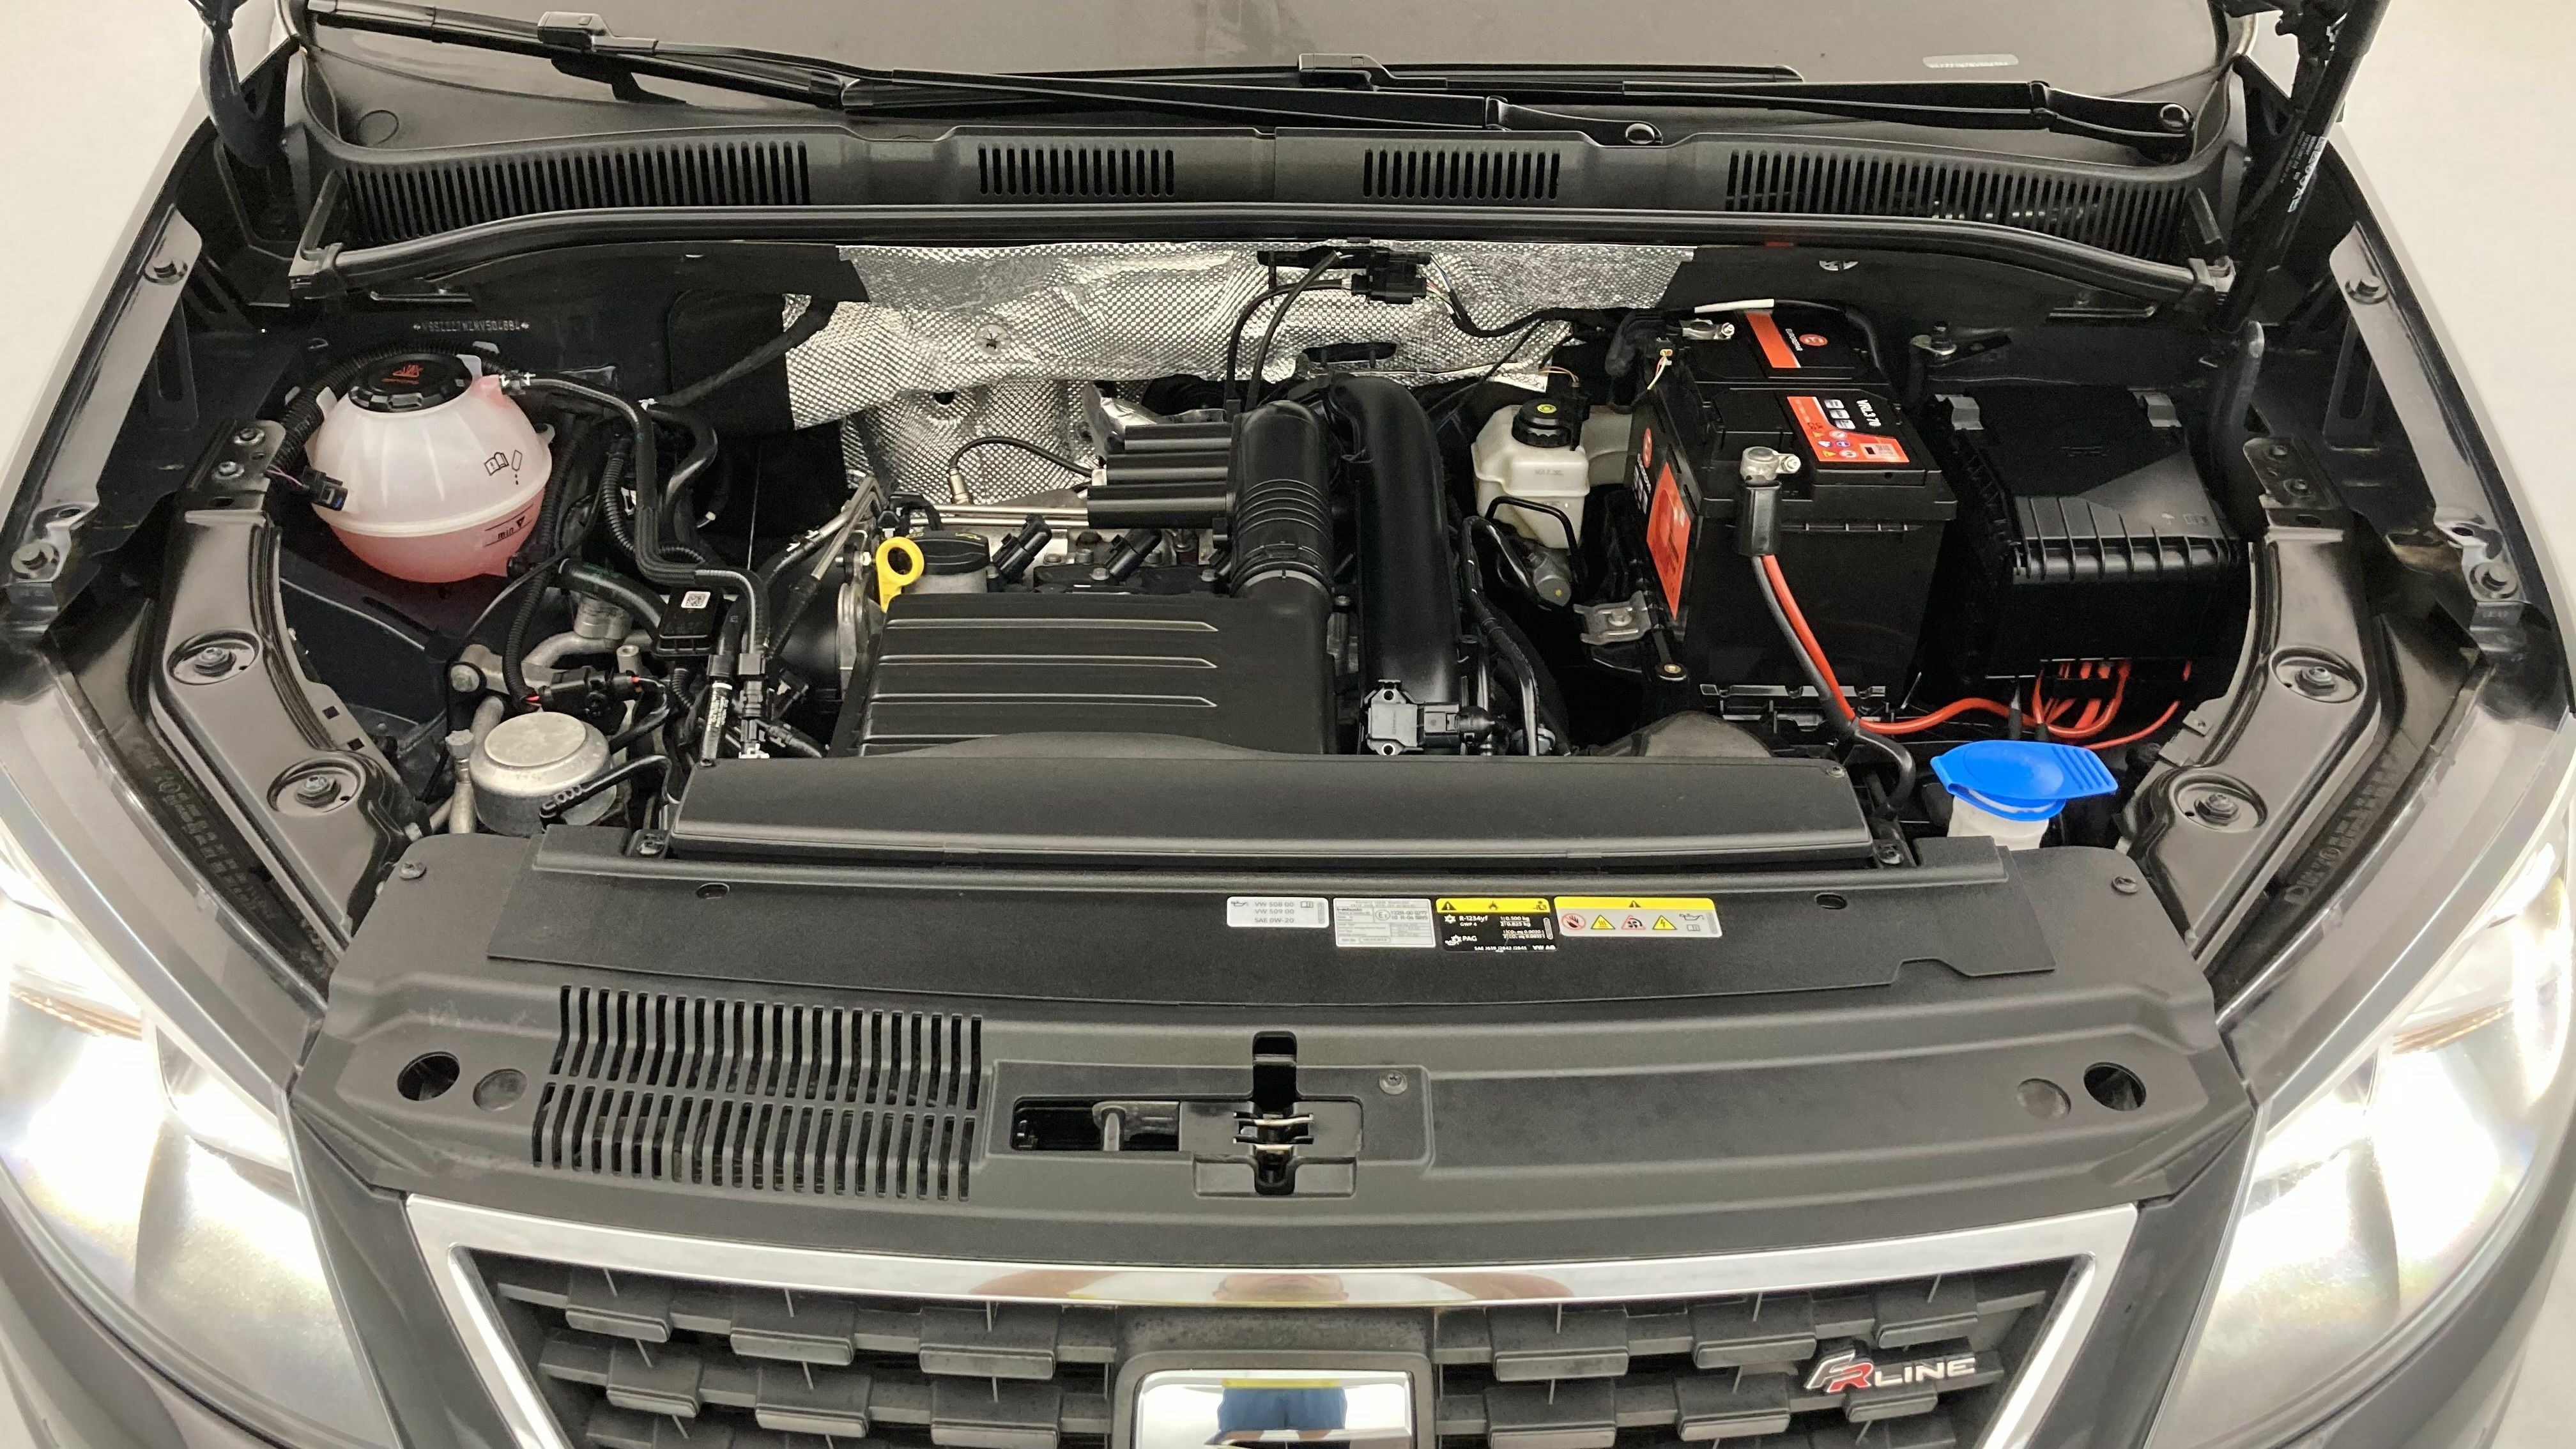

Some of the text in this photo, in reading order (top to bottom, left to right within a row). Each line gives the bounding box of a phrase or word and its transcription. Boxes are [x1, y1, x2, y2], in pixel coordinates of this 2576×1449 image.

[1856, 399, 1882, 426] VRL3 70
[498, 527, 514, 539] min
[1874, 1354, 1977, 1388] LINE
